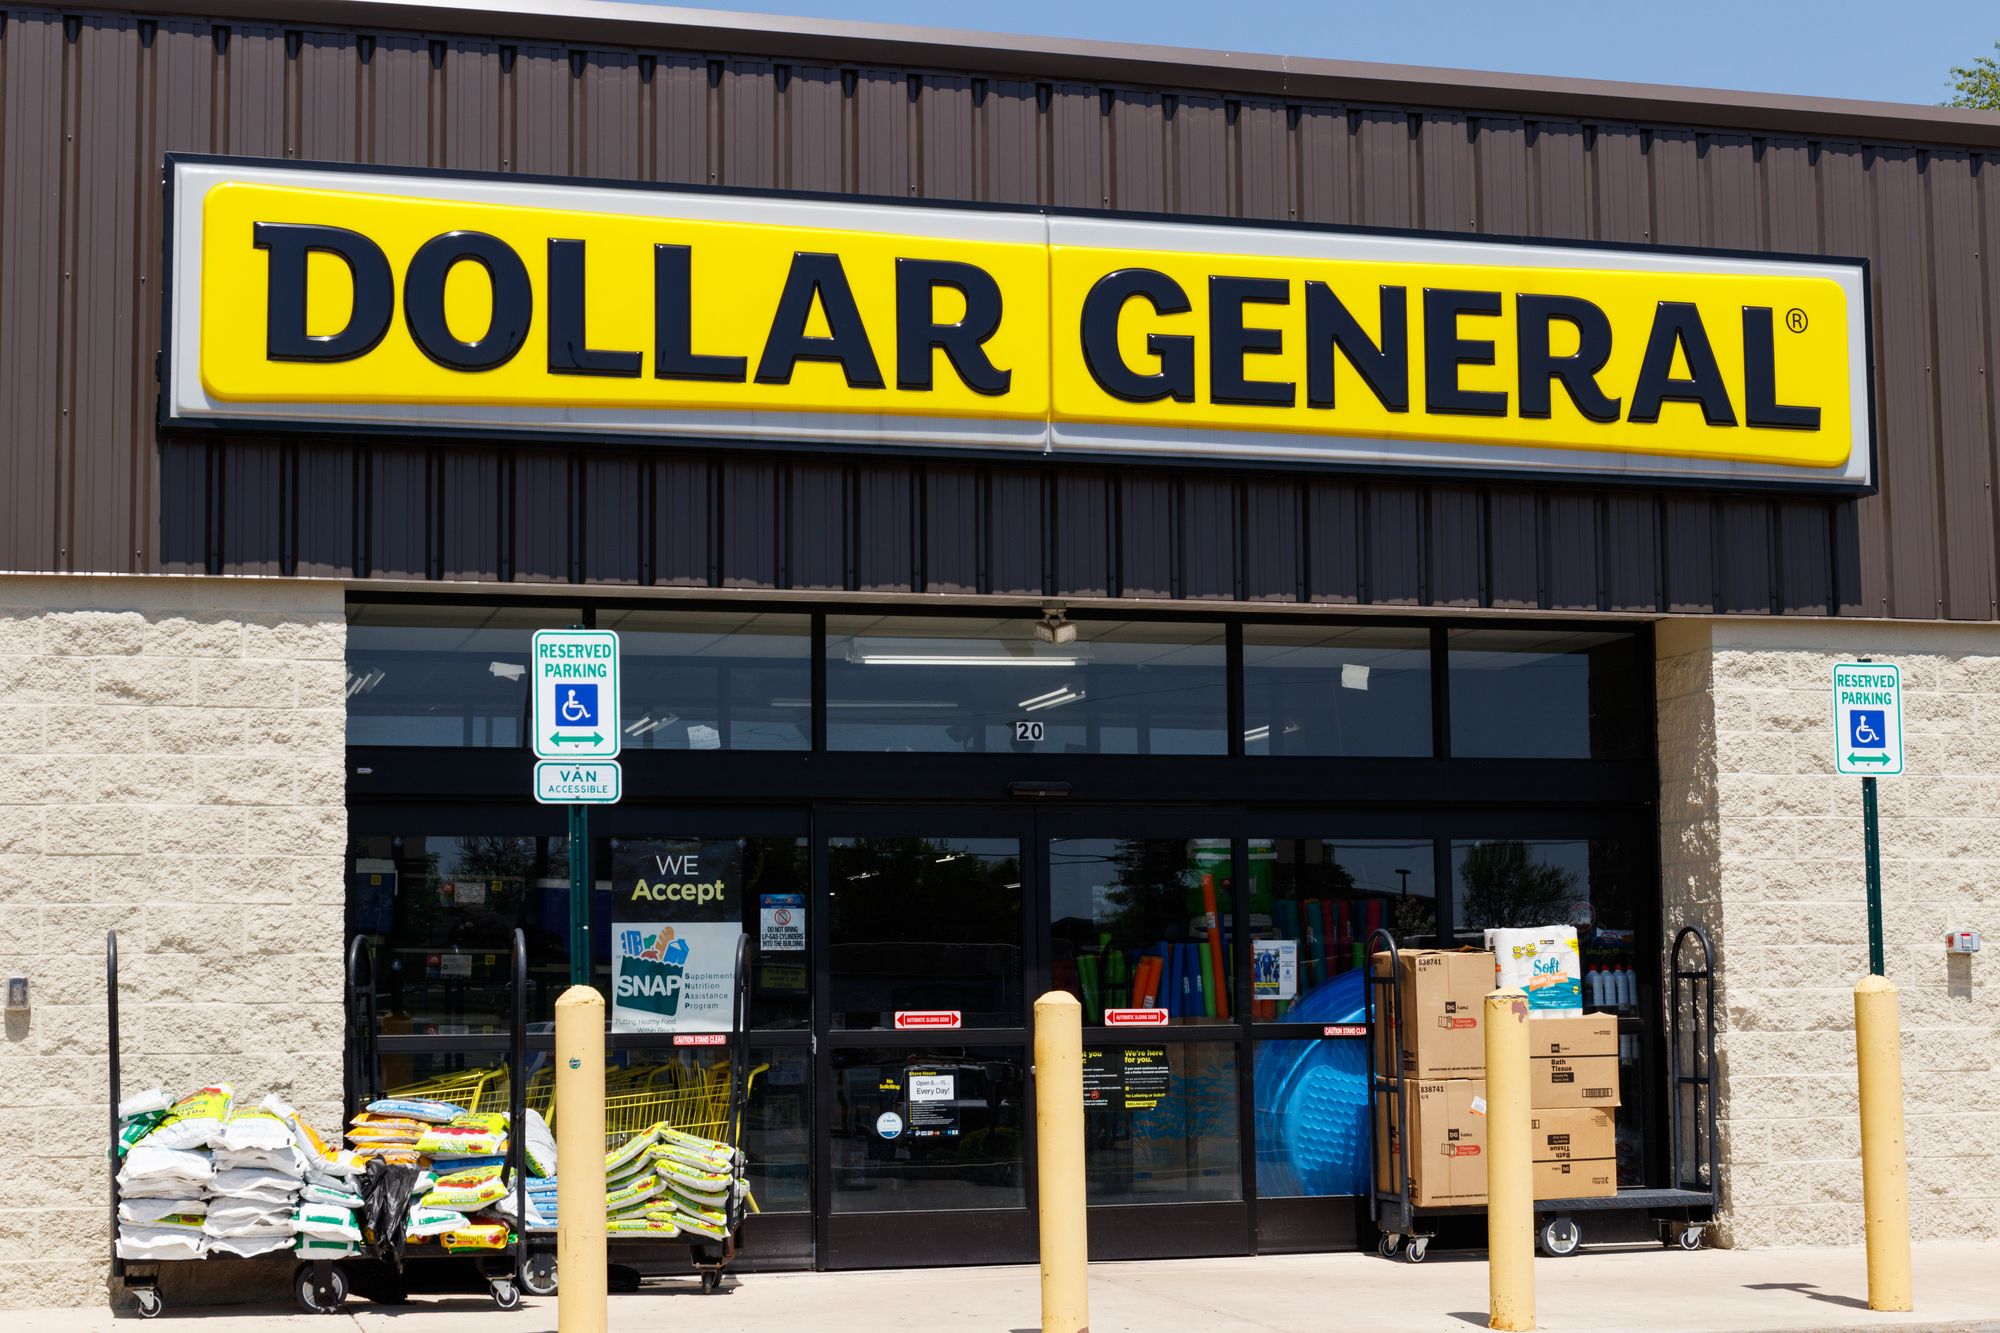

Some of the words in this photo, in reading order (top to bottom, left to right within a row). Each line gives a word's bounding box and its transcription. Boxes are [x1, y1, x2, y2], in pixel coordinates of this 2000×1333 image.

[253, 221, 1012, 396] DOLLAR
[540, 643, 612, 659] RESERVED
[545, 663, 607, 678] PARKING
[1837, 674, 1896, 688] RESERVED
[1841, 692, 1892, 705] PARKING
[1018, 722, 1042, 740] 20
[560, 770, 597, 782] VAN
[548, 785, 608, 794] ACCESSIBLE
[656, 855, 699, 876] WE
[631, 879, 725, 905] Accept
[1418, 958, 1442, 966] 838741
[1533, 957, 1560, 977] Soft
[618, 974, 682, 997] SNAP
[684, 982, 720, 990] Nutrition
[684, 992, 728, 1000] Assistance
[684, 1002, 719, 1010] Program
[1324, 1027, 1342, 1035] CAUTION
[1343, 1027, 1355, 1035] STAND
[676, 1035, 694, 1043] CAUTION
[694, 1035, 709, 1043] STAND
[936, 1087, 950, 1095] Day!
